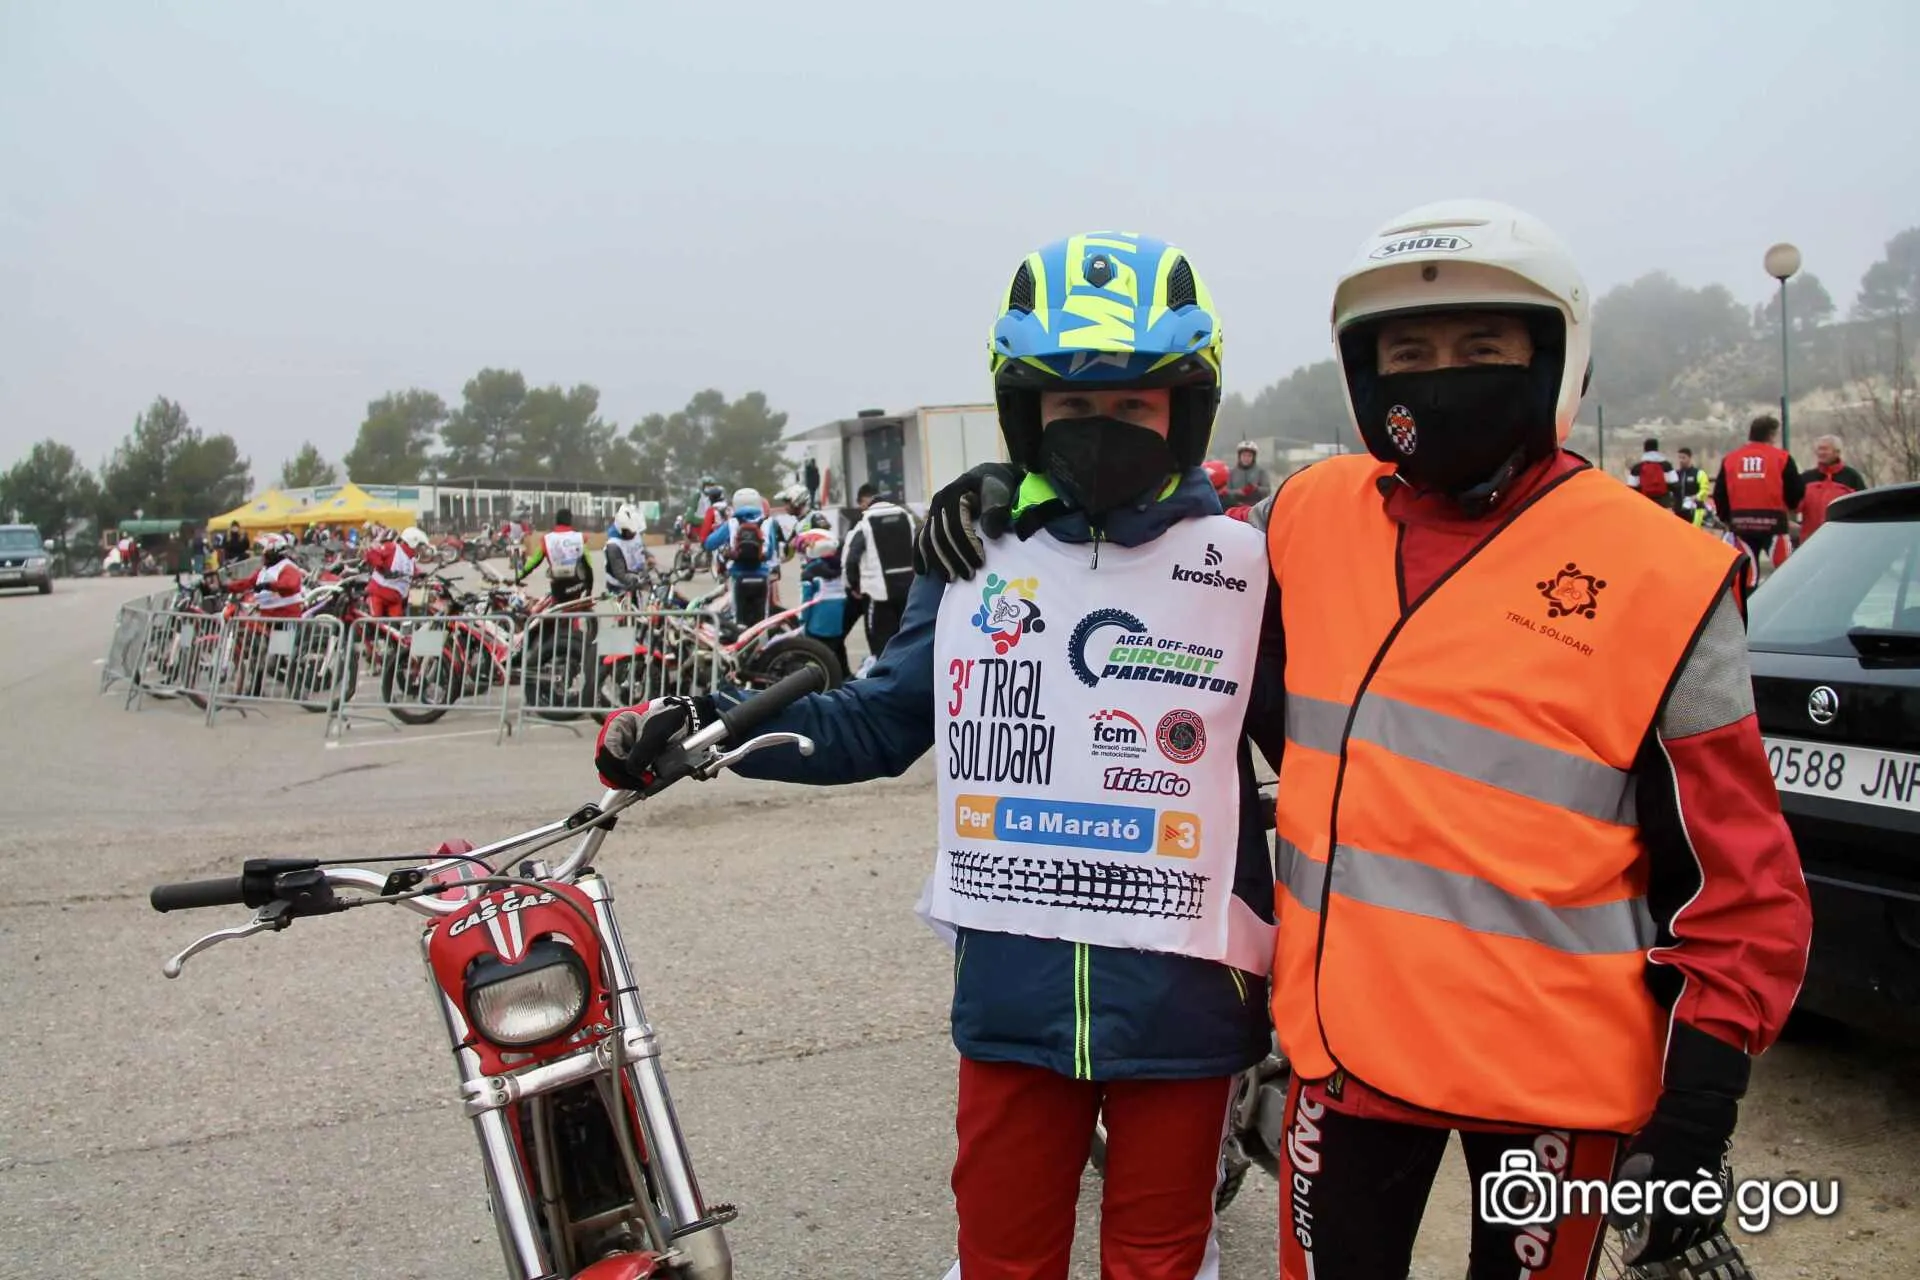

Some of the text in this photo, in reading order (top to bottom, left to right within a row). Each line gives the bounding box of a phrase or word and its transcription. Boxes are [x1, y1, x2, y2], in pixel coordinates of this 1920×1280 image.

[1382, 237, 1459, 256] SHOEI
[1116, 634, 1224, 660] AREA OFF-ROAD
[1505, 611, 1594, 657] TRIAL SOLIDARI
[1108, 647, 1220, 675] CIRCUIT
[1100, 664, 1239, 697] PARCMOTOR
[1093, 721, 1137, 744] fcm
[1103, 767, 1191, 798] TrialGo
[1768, 746, 1846, 791] 0588
[959, 806, 992, 829] Per
[1005, 809, 1033, 832] La
[1038, 811, 1141, 841] Marató
[449, 892, 557, 937] GAS GAS
